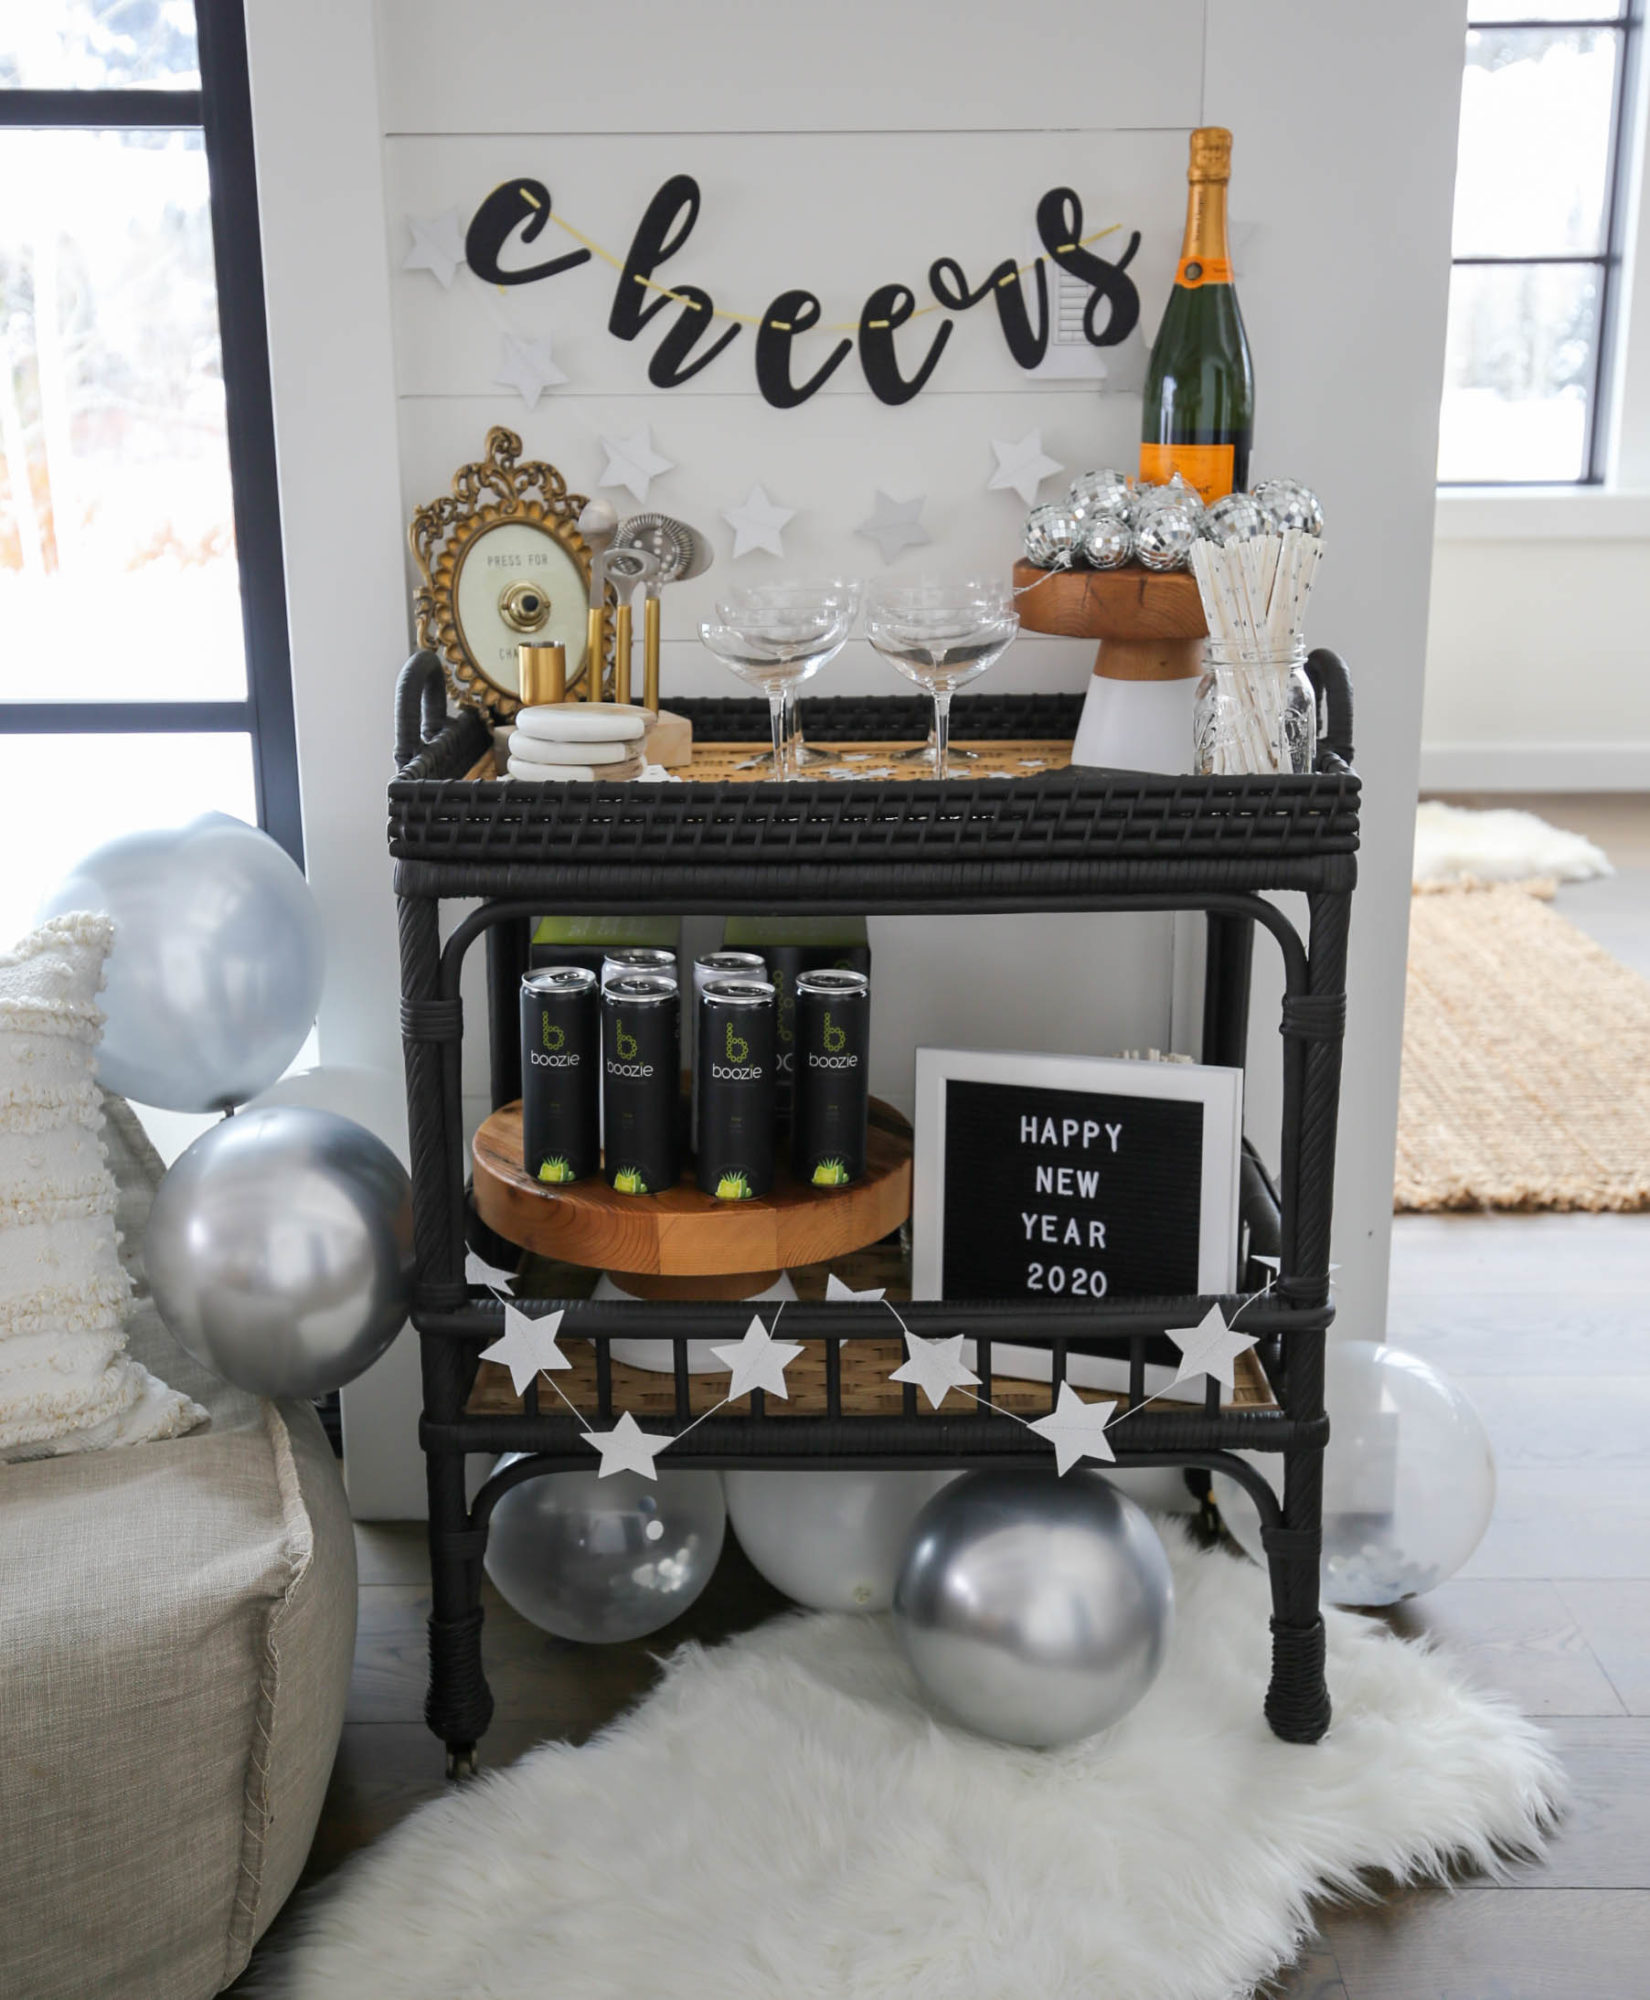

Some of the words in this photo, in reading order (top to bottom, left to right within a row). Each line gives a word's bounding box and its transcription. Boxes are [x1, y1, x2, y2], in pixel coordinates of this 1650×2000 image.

[465, 175, 1141, 409] cheers
[487, 555, 522, 567] PRESS
[528, 553, 548, 566] FOR
[530, 1050, 580, 1067] boozie
[606, 1059, 654, 1078] boozie
[712, 1063, 763, 1080] boozie
[808, 1052, 858, 1069] boozie
[1020, 1115, 1122, 1153] HAPPY
[1035, 1165, 1100, 1199] NEW
[1021, 1212, 1106, 1249] YEAR
[1027, 1262, 1107, 1298] 2020
